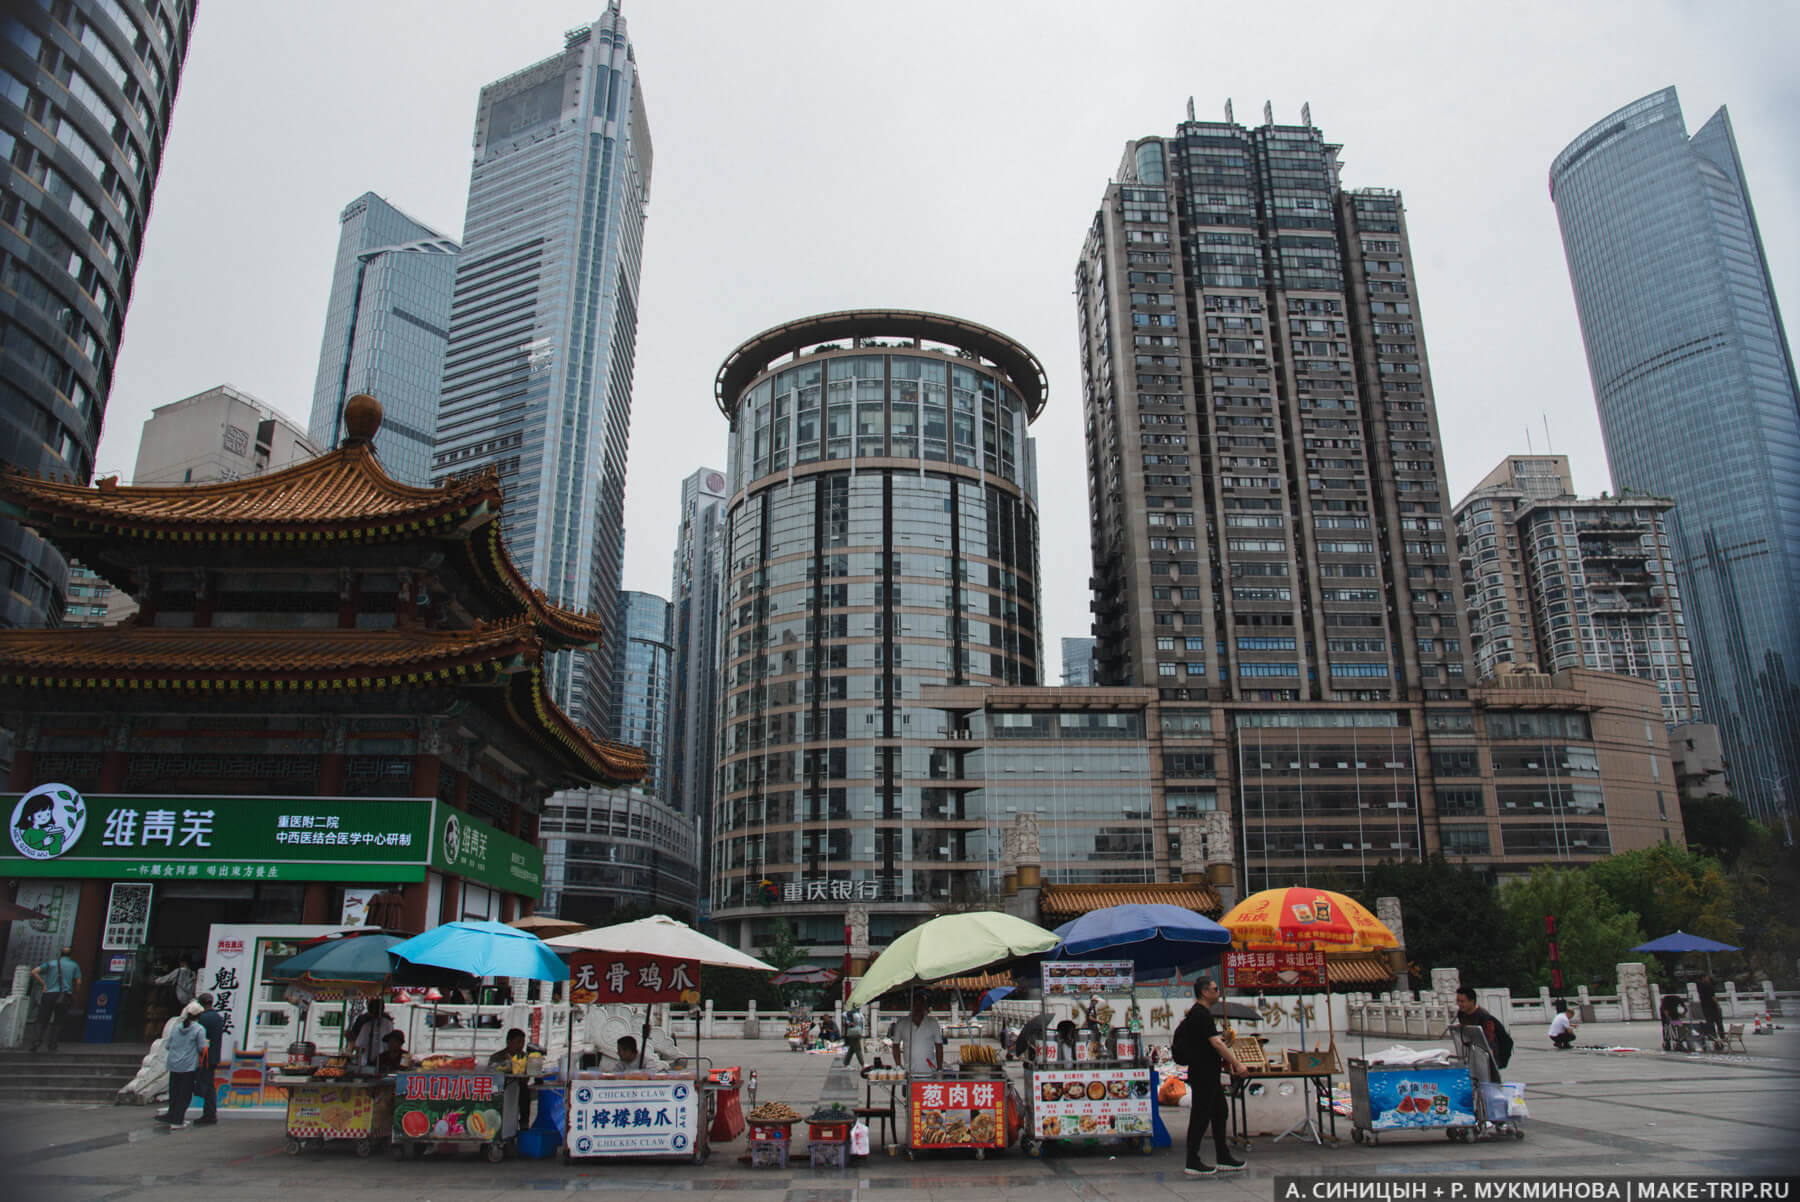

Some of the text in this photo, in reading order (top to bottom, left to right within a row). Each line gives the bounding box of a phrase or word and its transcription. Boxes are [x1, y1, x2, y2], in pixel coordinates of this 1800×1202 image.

[102, 808, 216, 847] 维青芜
[277, 815, 340, 829] 重医附二院
[276, 831, 412, 847] 中西医结合医学中心研制
[783, 880, 880, 902] 重庆银行
[573, 962, 696, 994] 无骨鸡爪
[406, 1075, 493, 1100] 现切水果
[598, 1089, 666, 1099] CHICKEN CLAW
[921, 1083, 995, 1108] 葱肉饼
[597, 1138, 665, 1148] CHICKEN CLAW
